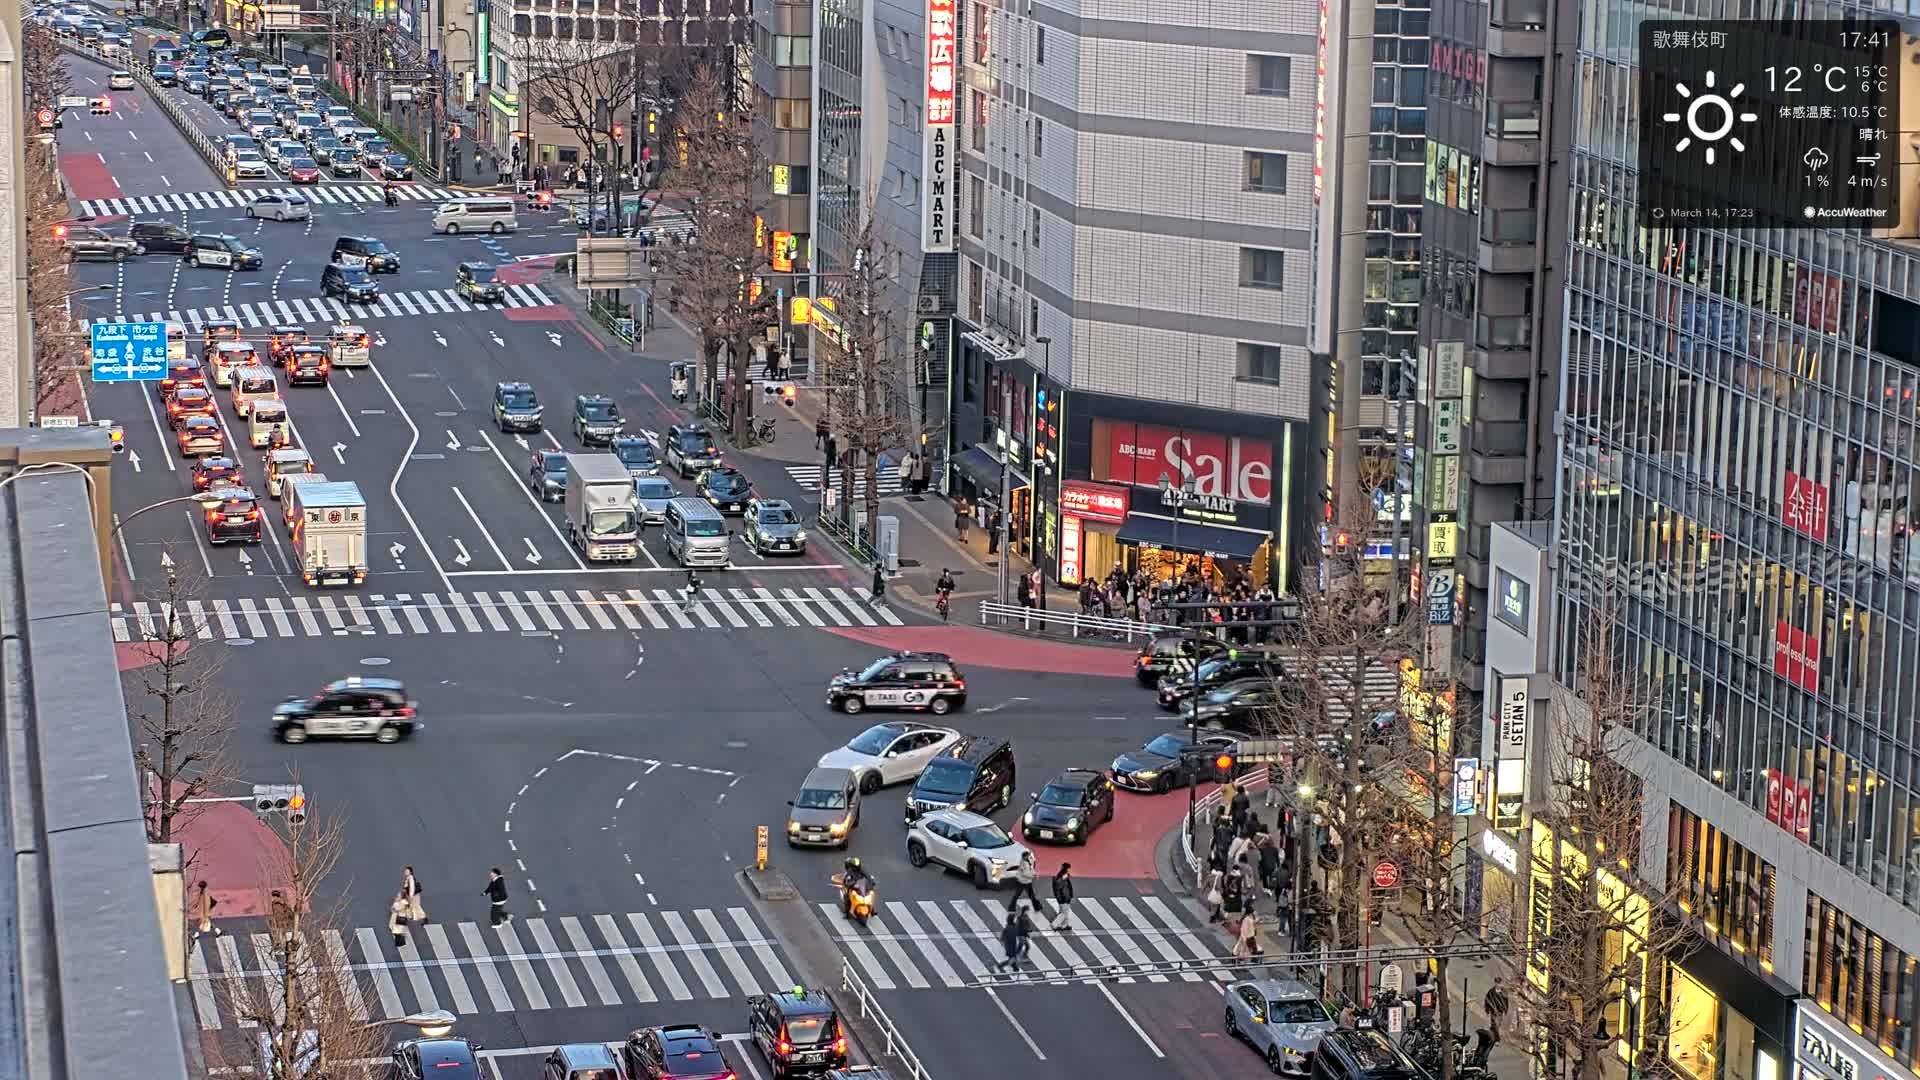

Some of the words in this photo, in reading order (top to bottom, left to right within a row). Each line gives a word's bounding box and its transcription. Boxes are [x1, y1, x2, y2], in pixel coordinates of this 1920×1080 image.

[1432, 43, 1486, 82] AMIGO
[1119, 443, 1156, 457] ABCMART
[1164, 436, 1271, 504] Sale
[1788, 482, 1824, 532] 会計
[1433, 526, 1447, 554] 買取
[1503, 702, 1512, 719] CITY
[1513, 691, 1525, 702] 5
[1503, 721, 1511, 740] PARK
[1511, 706, 1524, 746] ISETAN
